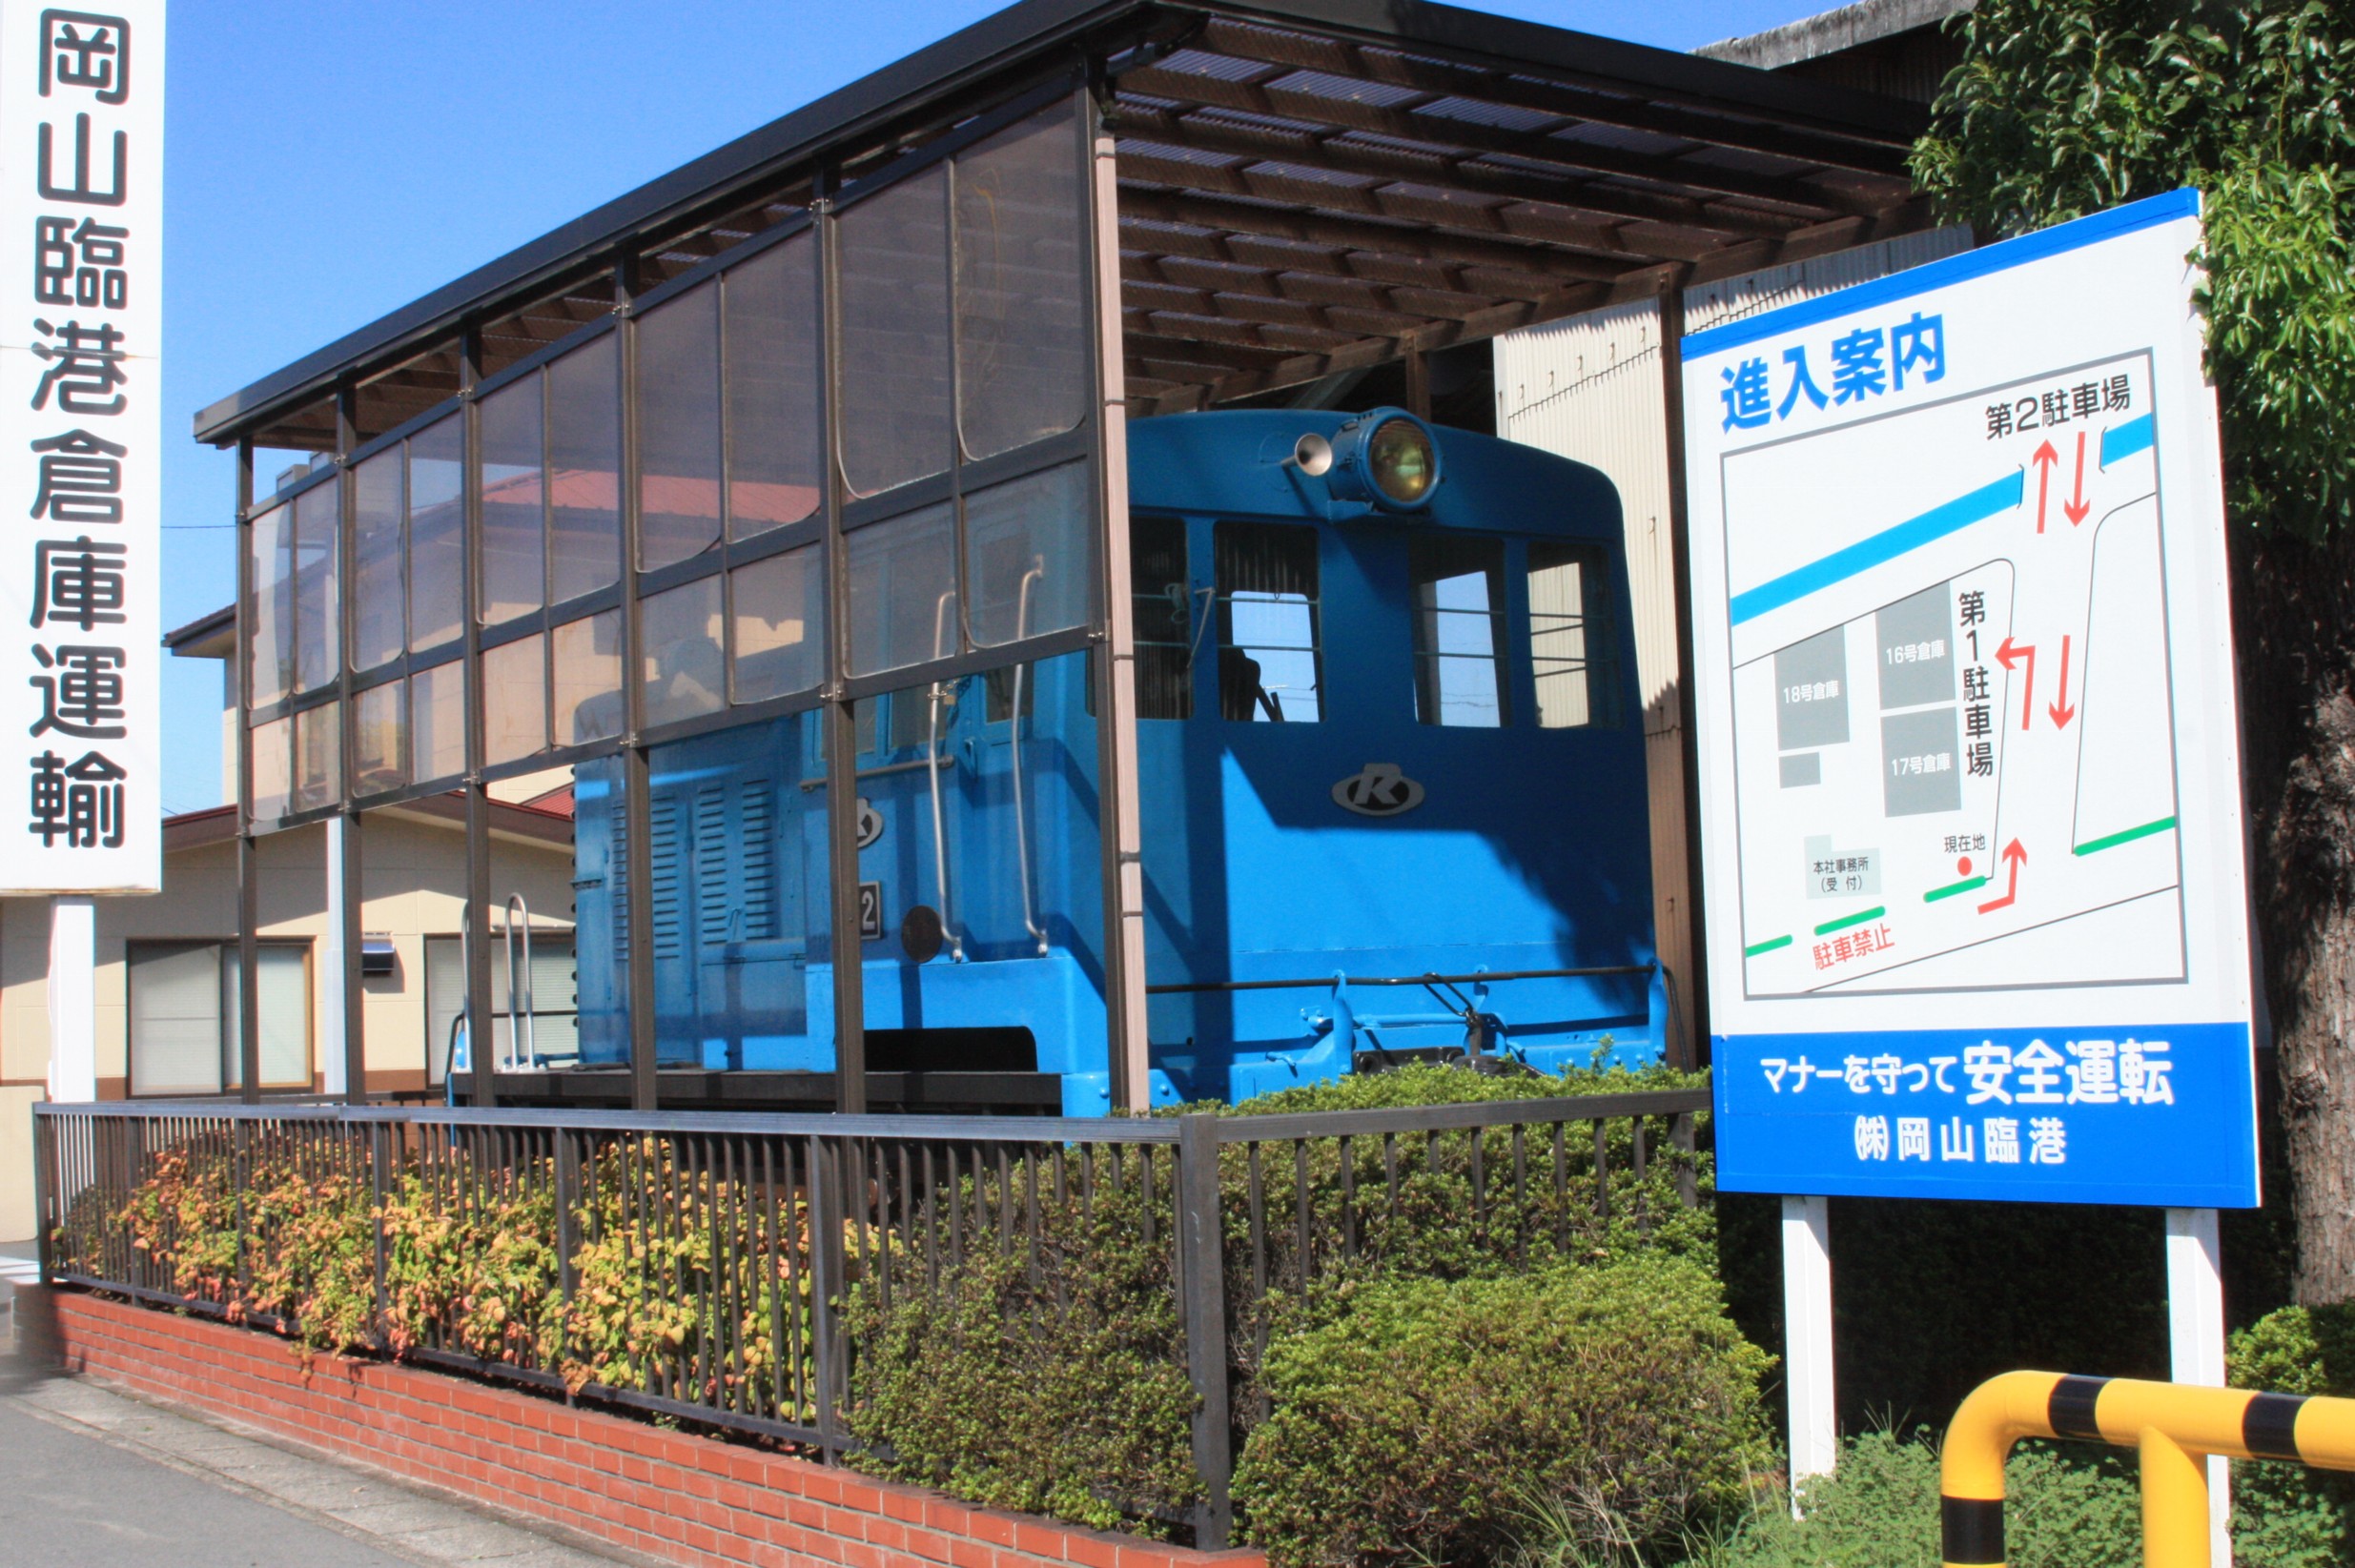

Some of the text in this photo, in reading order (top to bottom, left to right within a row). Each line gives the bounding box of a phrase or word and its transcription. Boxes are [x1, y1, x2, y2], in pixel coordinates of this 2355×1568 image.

[1720, 311, 1946, 434] 進入案内
[1986, 374, 2131, 440] 第2駐車場
[30, 9, 132, 847] 岡山臨港倉庫運輸
[1885, 639, 1946, 665] 16号倉庫
[1783, 679, 1840, 704] 18号倉庫
[1958, 590, 1994, 777] 第1駐車場
[1891, 752, 1952, 777] 17号倉庫
[1944, 832, 1986, 854] 現在地
[1812, 856, 1870, 875] 本社事務所
[1812, 922, 1895, 970] 駐車禁止
